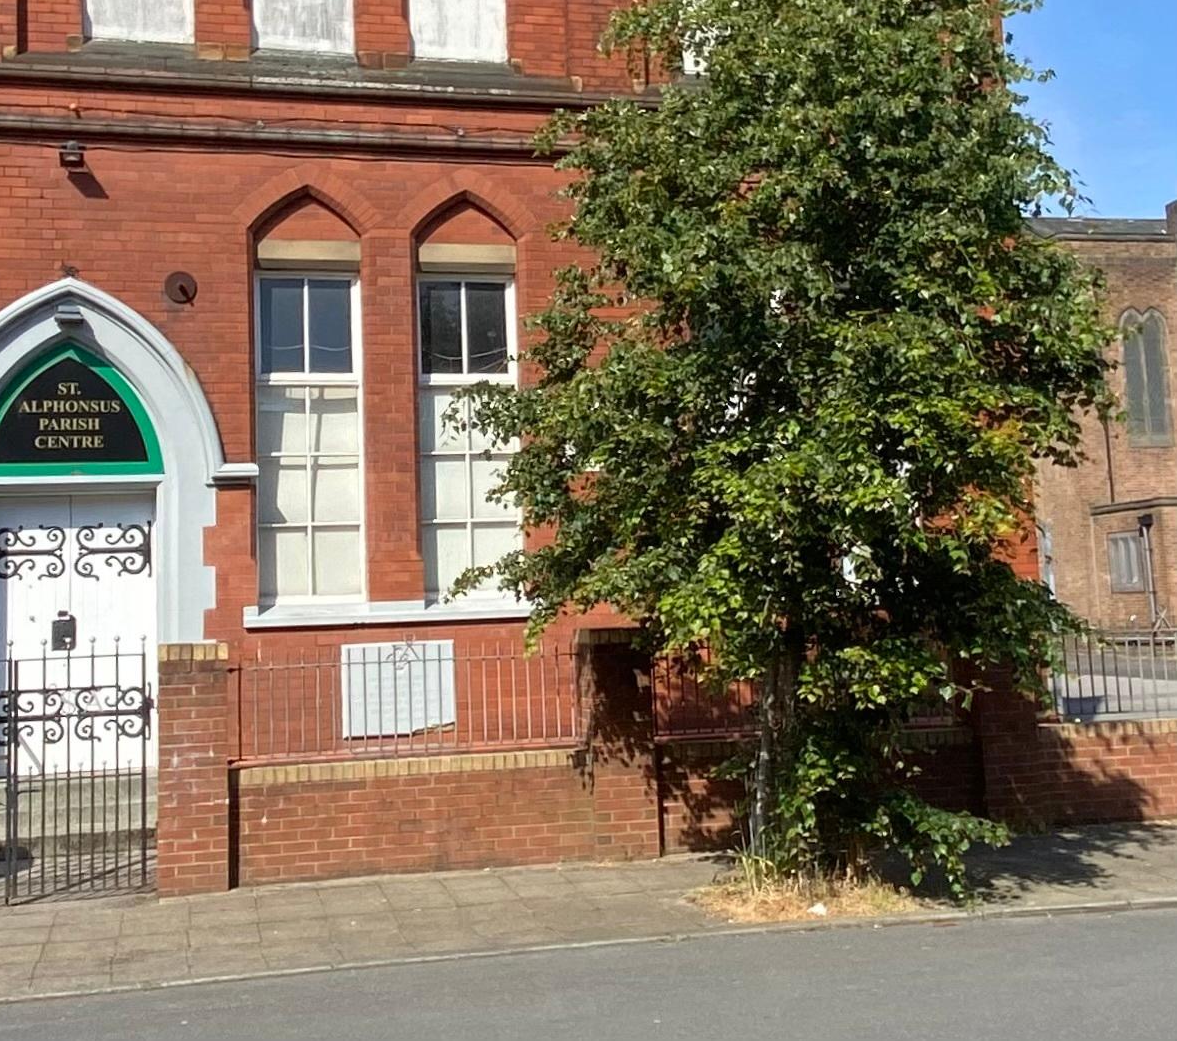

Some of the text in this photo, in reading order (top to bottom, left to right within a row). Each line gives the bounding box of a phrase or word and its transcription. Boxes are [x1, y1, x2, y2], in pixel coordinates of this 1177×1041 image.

[57, 382, 82, 395] ST.
[19, 400, 121, 413] ALPHONSUS
[38, 418, 100, 431] PARISH
[34, 435, 104, 449] CENTRE
